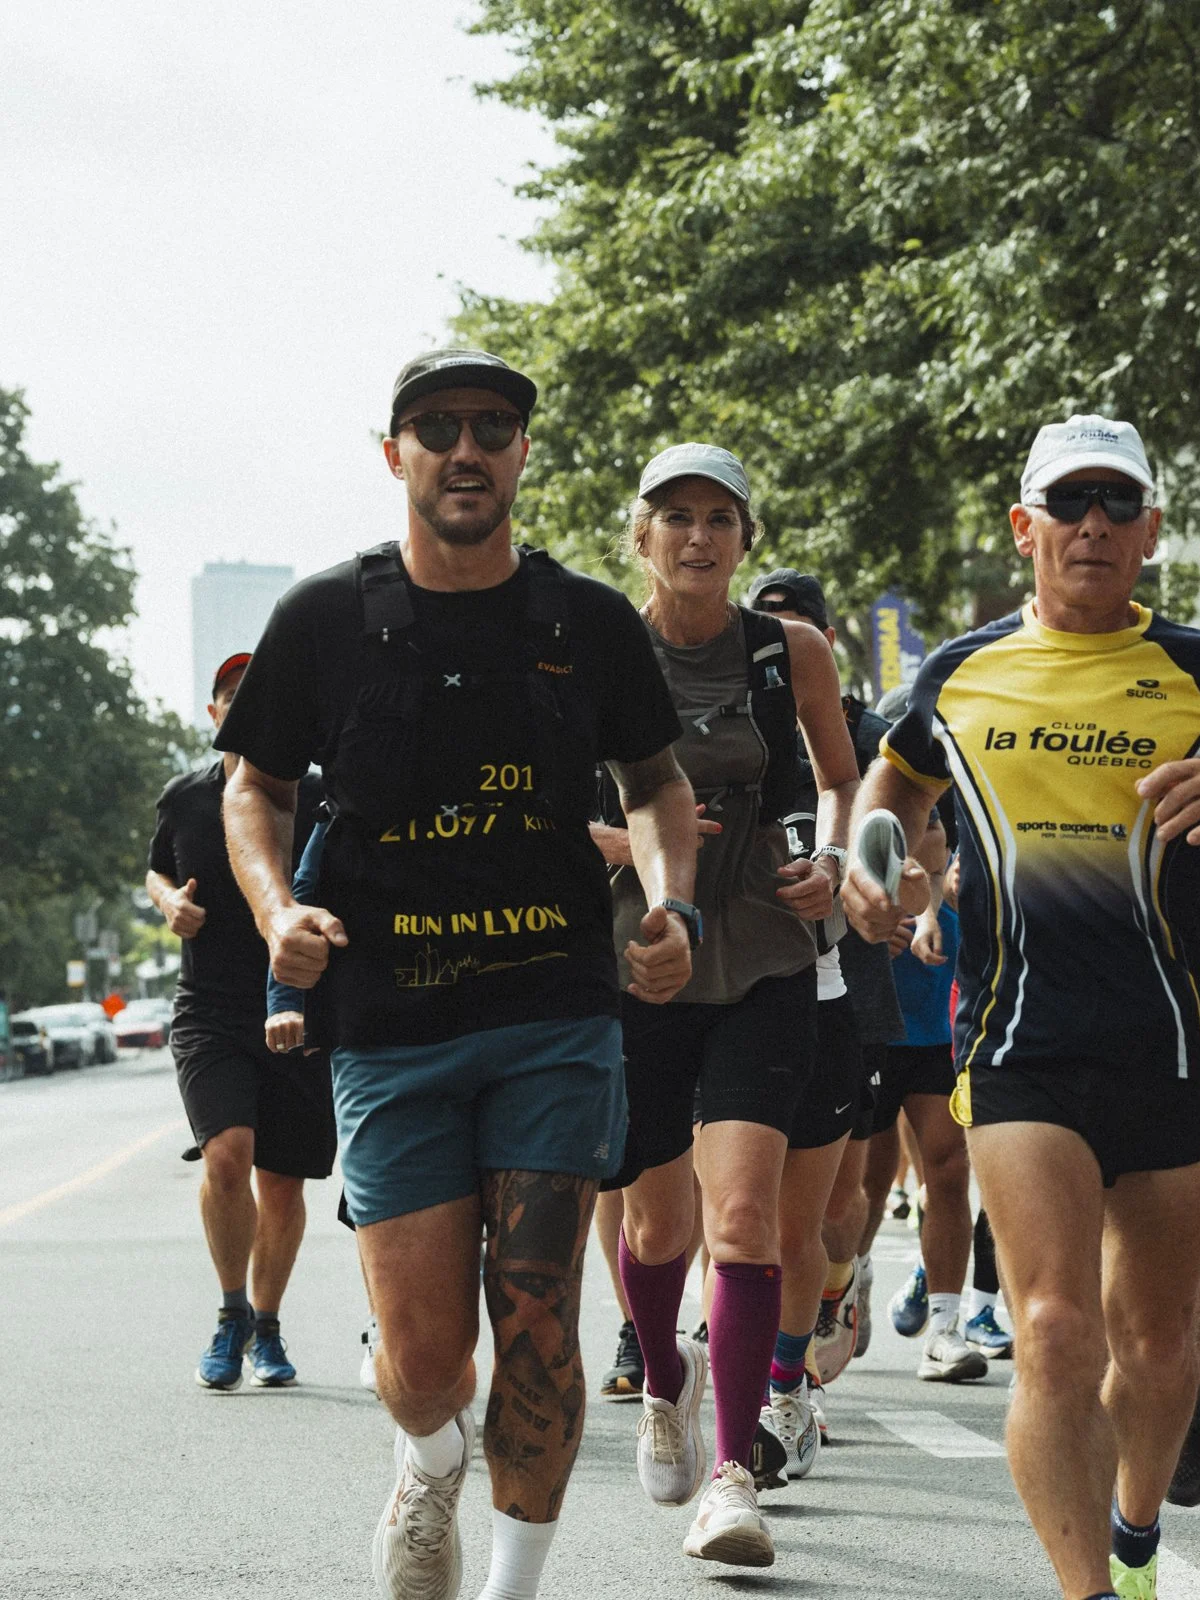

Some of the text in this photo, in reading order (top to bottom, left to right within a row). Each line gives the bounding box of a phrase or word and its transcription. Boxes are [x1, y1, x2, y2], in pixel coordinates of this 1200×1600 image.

[1051, 721, 1097, 731] CLUB
[984, 726, 1157, 757] la foulée
[1067, 754, 1153, 769] QUÉBEC
[479, 764, 534, 791] 201
[1016, 821, 1109, 834] sports experts
[394, 904, 568, 936] RUN IN LYON
